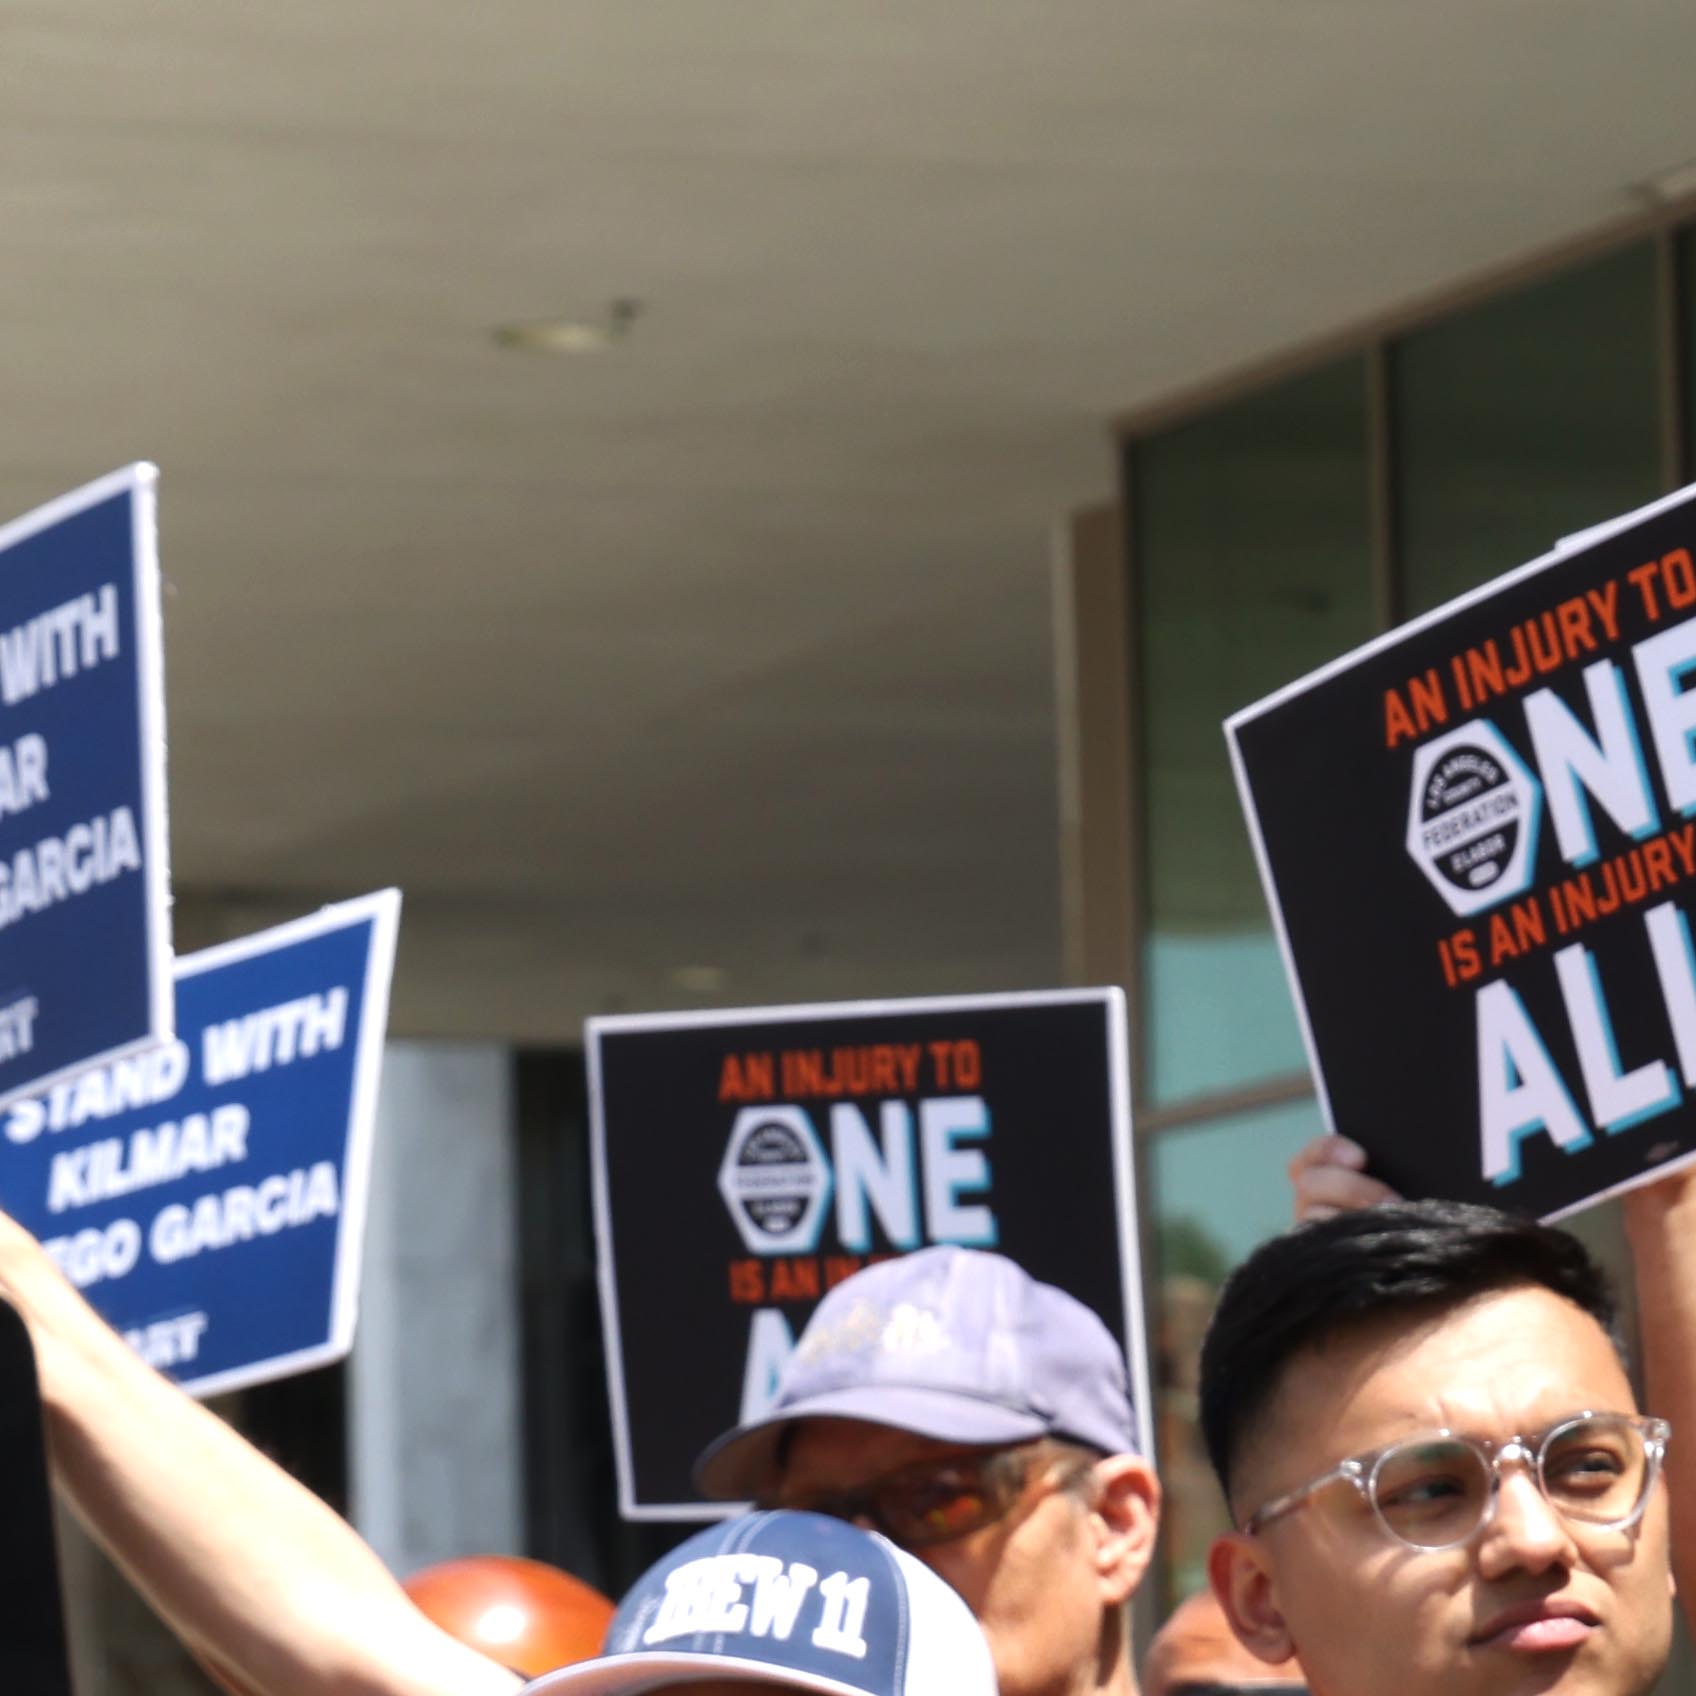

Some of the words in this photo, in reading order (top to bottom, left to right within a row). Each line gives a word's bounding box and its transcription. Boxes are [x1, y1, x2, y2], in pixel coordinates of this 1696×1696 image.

[1385, 679, 1451, 750] AN
[1452, 591, 1625, 714] INJURY
[1423, 793, 1520, 851] FEDERATION
[1437, 937, 1477, 989] IS
[1488, 895, 1546, 967] AN
[202, 985, 350, 1087] WITH
[718, 1054, 774, 1103] AN
[780, 1044, 922, 1097] INJURY
[927, 1039, 982, 1091] TO
[47, 1103, 251, 1214] KILMAR
[149, 1160, 341, 1265] GARCIA
[729, 1259, 766, 1302] IS
[770, 1257, 819, 1300] AN
[812, 1570, 872, 1660] 11
